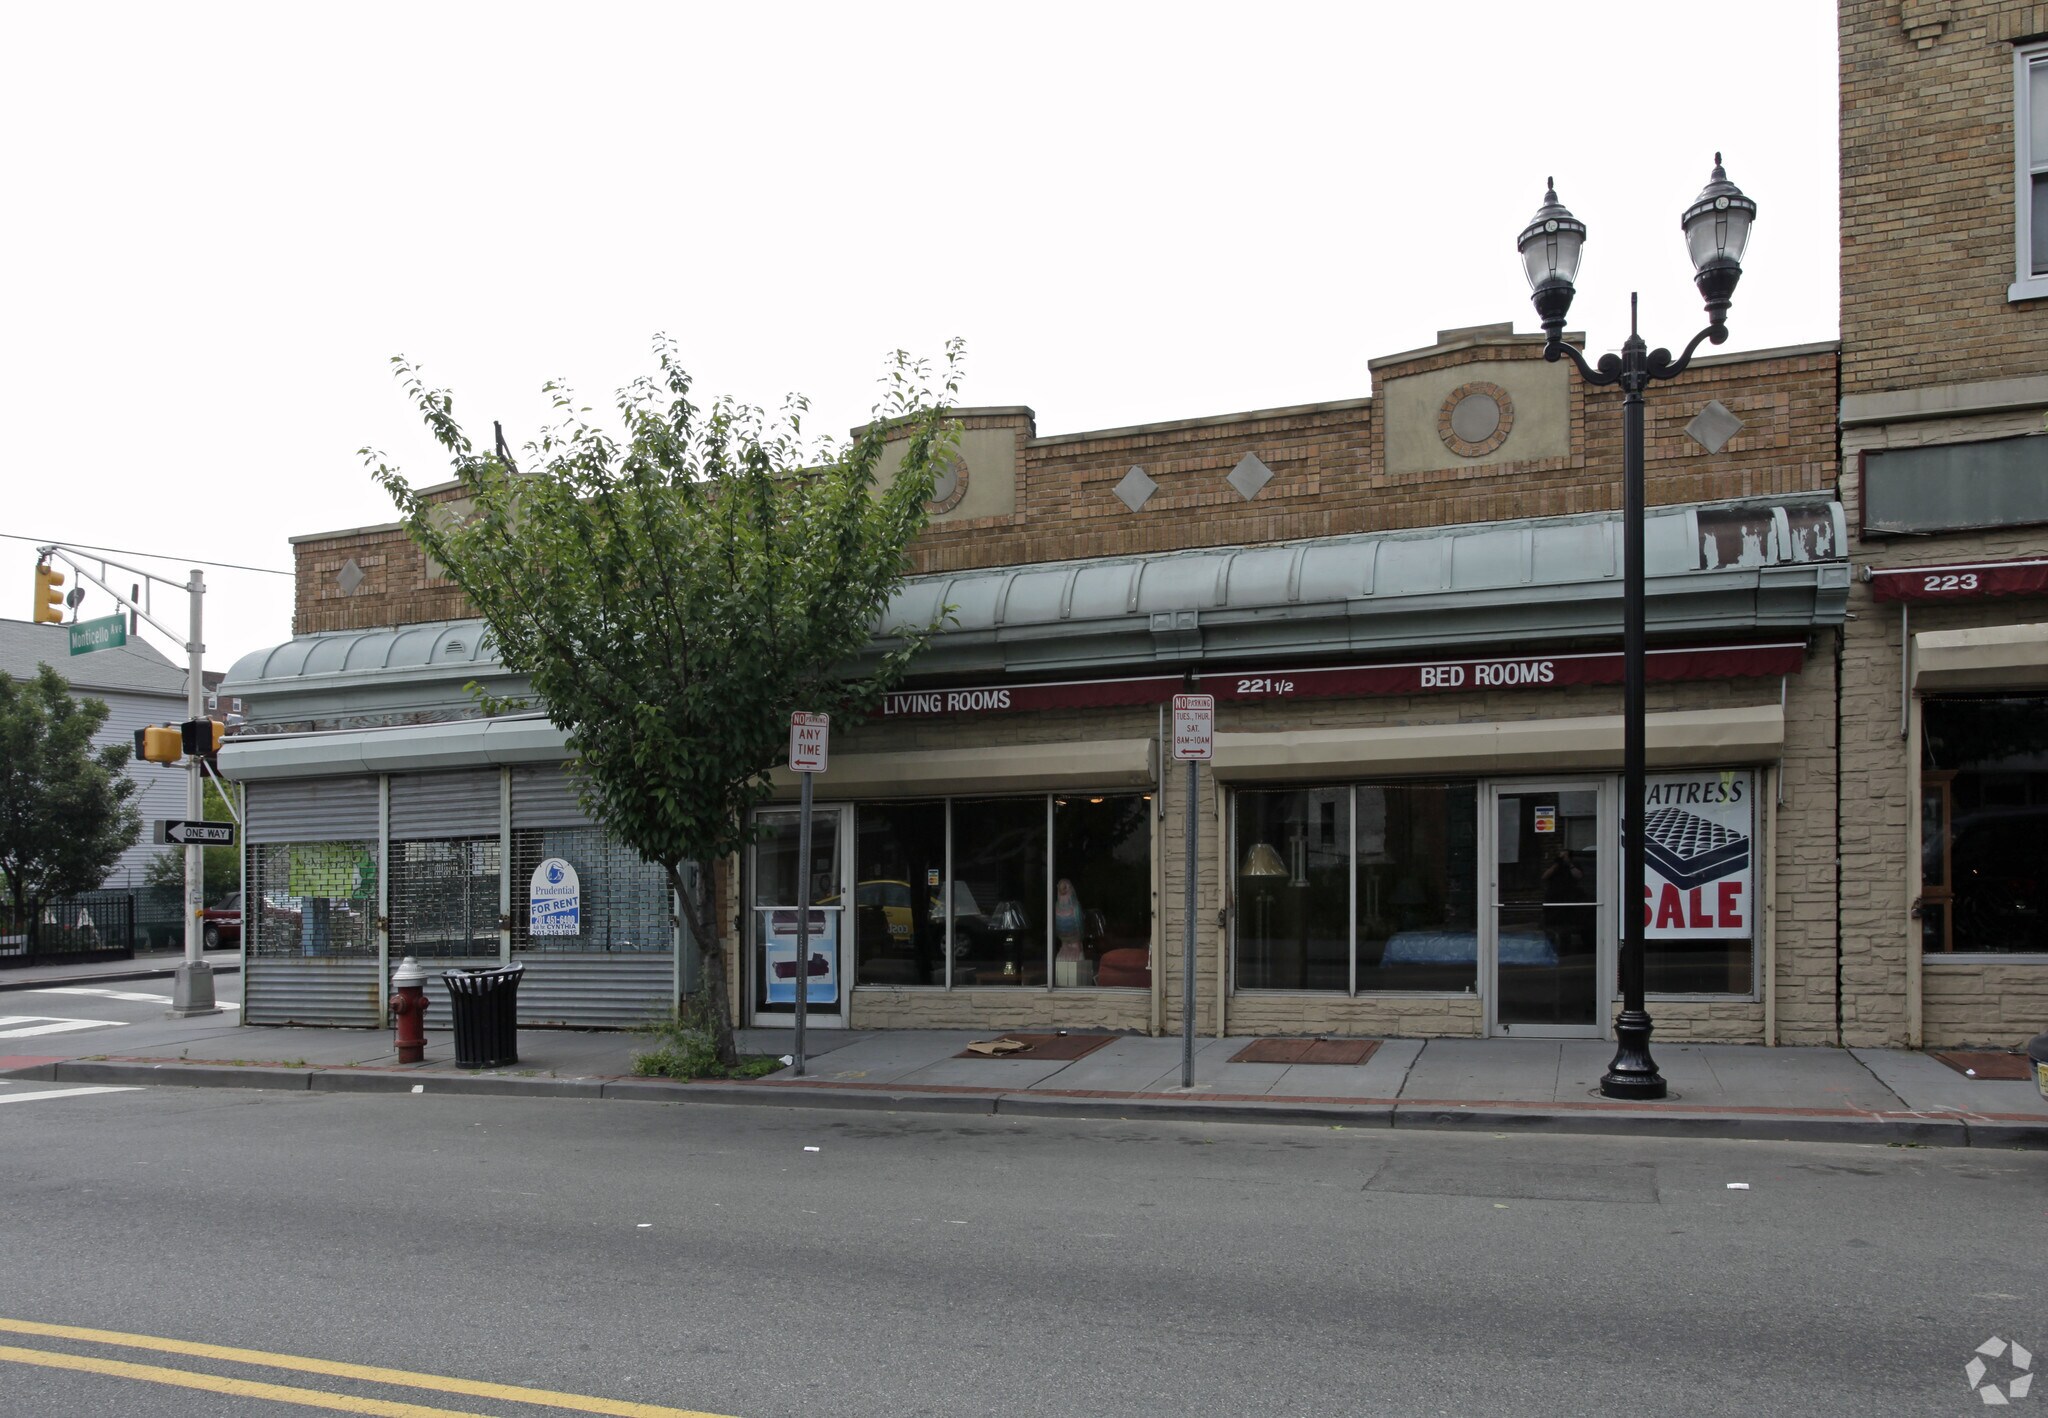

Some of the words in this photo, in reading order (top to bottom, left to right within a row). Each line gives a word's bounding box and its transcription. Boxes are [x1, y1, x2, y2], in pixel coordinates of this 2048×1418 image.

[1924, 574, 1978, 591] 223
[72, 626, 109, 649] Monticello
[110, 624, 122, 634] Ave
[1421, 666, 1465, 687] BED
[1475, 662, 1554, 685] ROOMS
[1237, 679, 1271, 693] 221
[1274, 680, 1294, 694] 1/2
[884, 694, 942, 714] LIVING
[947, 690, 1011, 711] ROOMS
[1175, 697, 1187, 709] NO
[1187, 699, 1211, 707] PARKING
[793, 714, 805, 725] NO
[799, 729, 821, 740] ANY
[1177, 736, 1210, 744] 8AM-10AM
[798, 744, 821, 755] TIME
[1645, 780, 1744, 805] ATTRESS
[185, 828, 204, 838] ONE
[207, 829, 227, 838] WAY
[535, 885, 575, 895] Prudential
[531, 904, 551, 915] FOR
[553, 896, 579, 910] RENT
